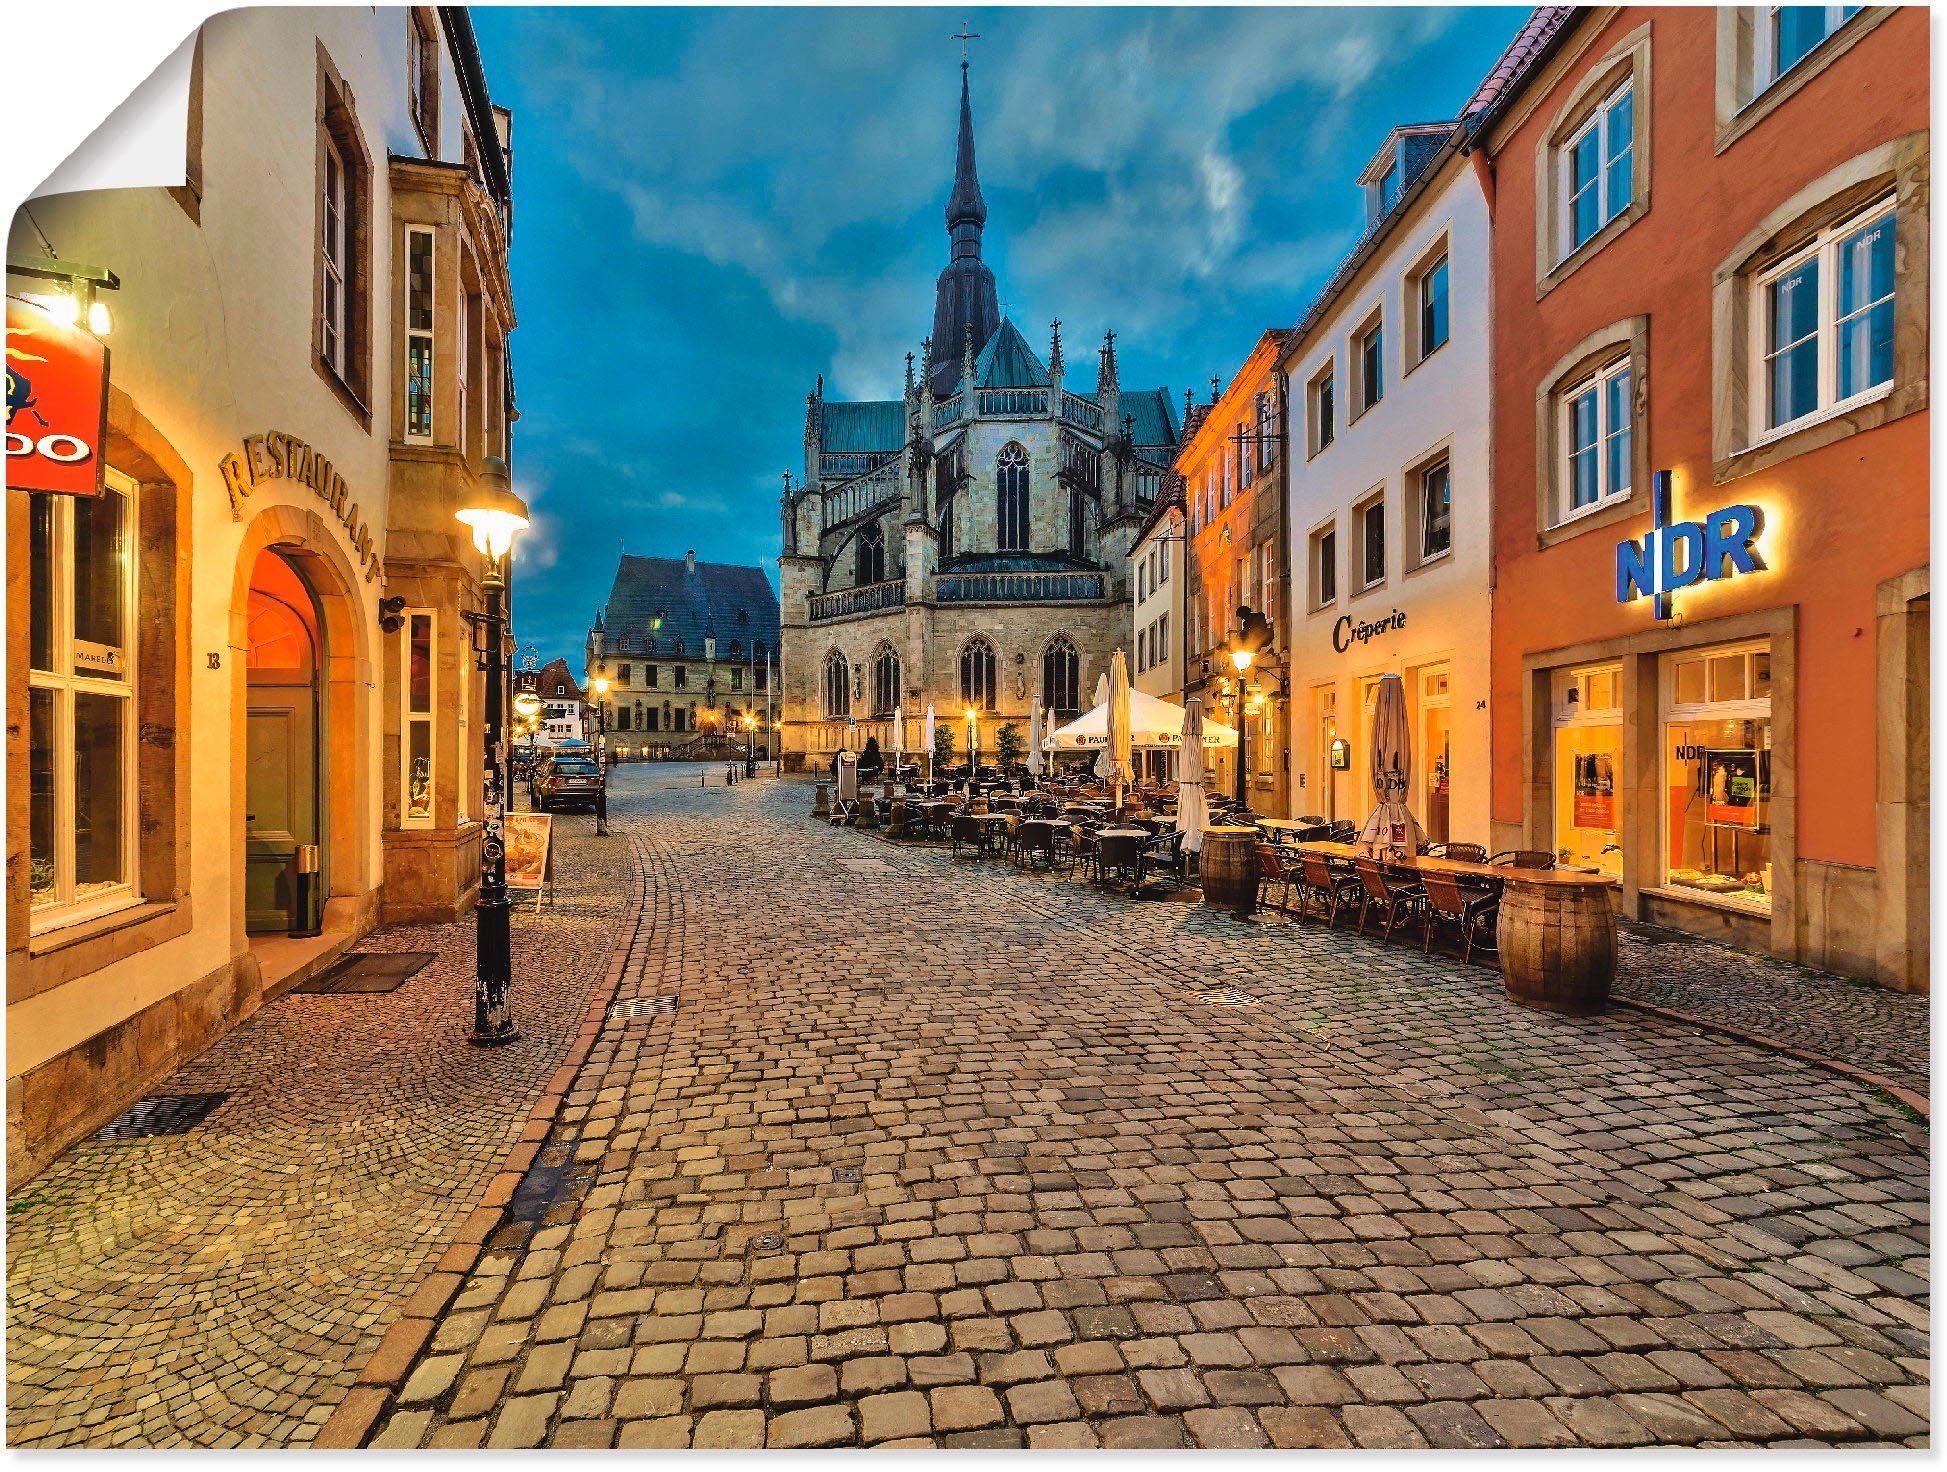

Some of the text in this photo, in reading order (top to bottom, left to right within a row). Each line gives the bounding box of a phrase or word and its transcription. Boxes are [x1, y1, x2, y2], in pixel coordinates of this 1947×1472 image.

[1856, 229, 1881, 251] NDR
[1781, 276, 1803, 294] NDR
[218, 430, 383, 584] RESTAURANT
[1616, 504, 1764, 603] NDR
[1333, 608, 1406, 653] Crêperie
[206, 652, 221, 670] 13
[1476, 699, 1487, 710] 24
[1172, 734, 1220, 744] PANER
